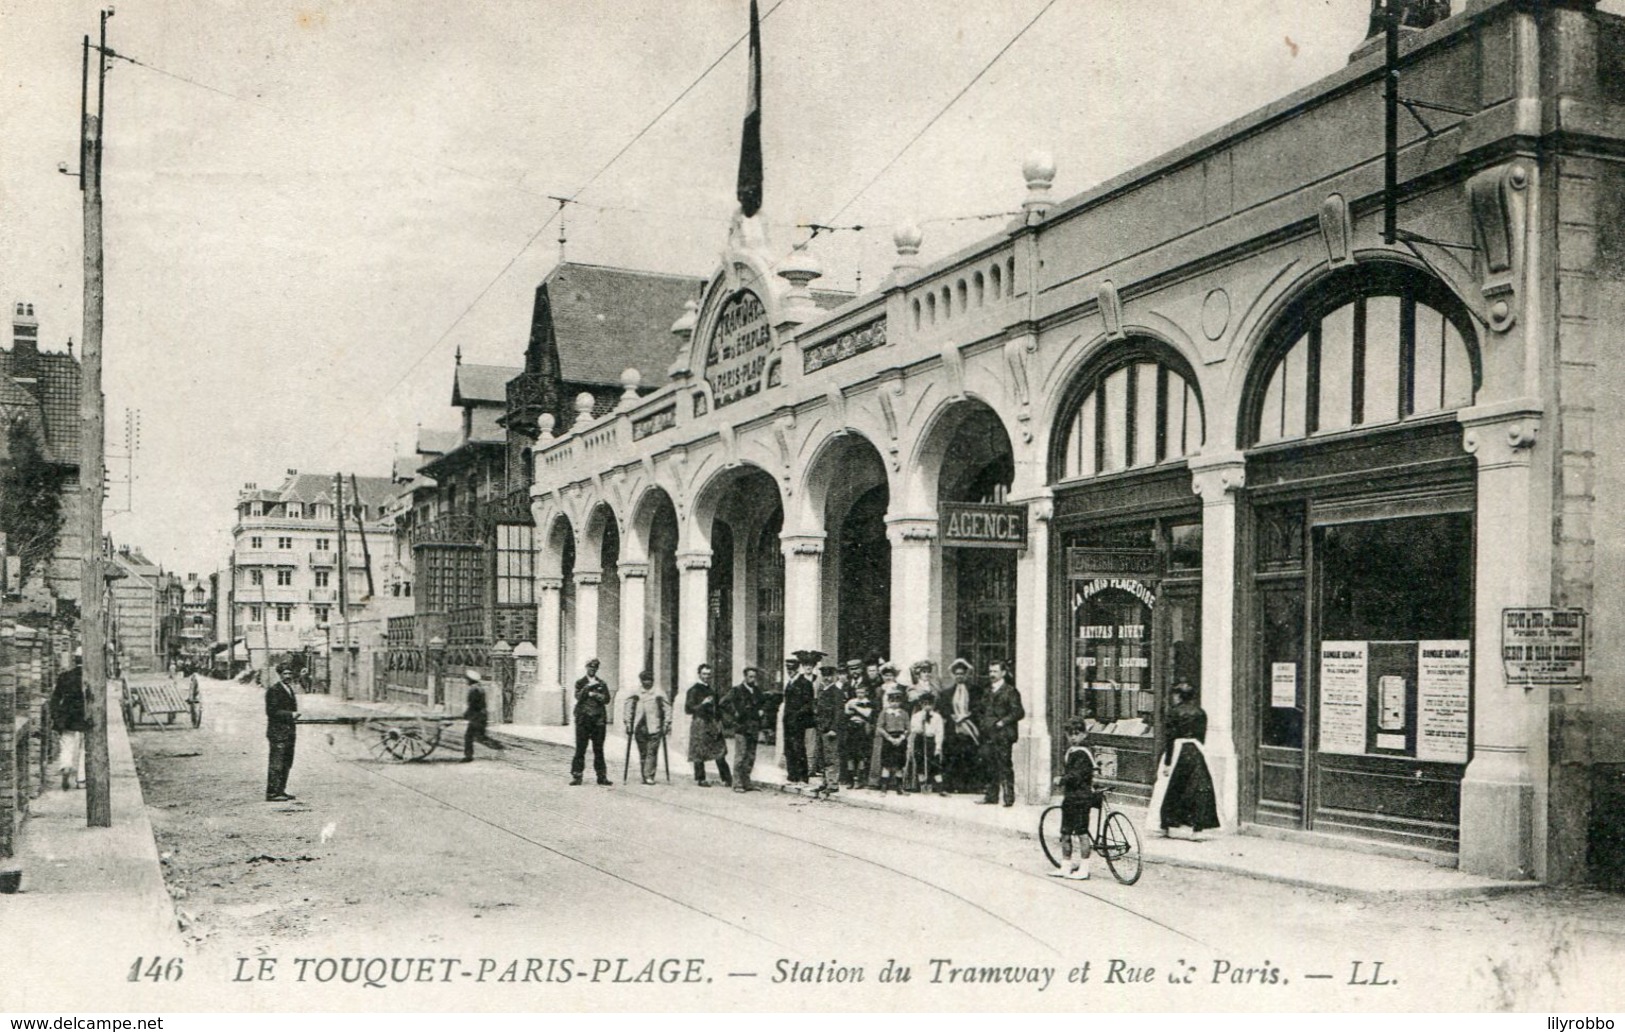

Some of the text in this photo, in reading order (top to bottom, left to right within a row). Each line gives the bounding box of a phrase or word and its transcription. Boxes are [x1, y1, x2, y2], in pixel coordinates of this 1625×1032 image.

[946, 511, 1020, 539] AGENCE
[1071, 578, 1156, 611] LA PARIS PLAGEOISE
